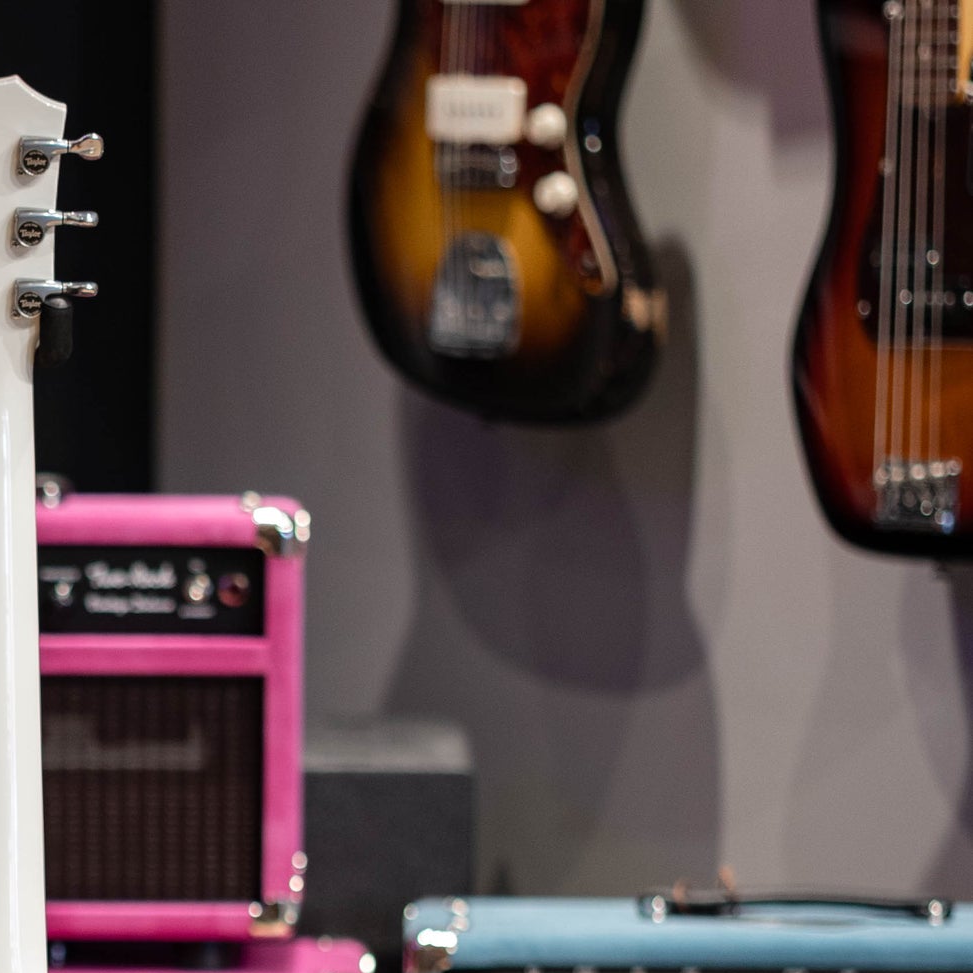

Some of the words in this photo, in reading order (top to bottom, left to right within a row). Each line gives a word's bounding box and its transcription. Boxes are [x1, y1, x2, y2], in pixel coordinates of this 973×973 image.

[24, 157, 47, 168] Taylor
[20, 228, 42, 239] Taylor
[19, 299, 41, 310] Taylor
